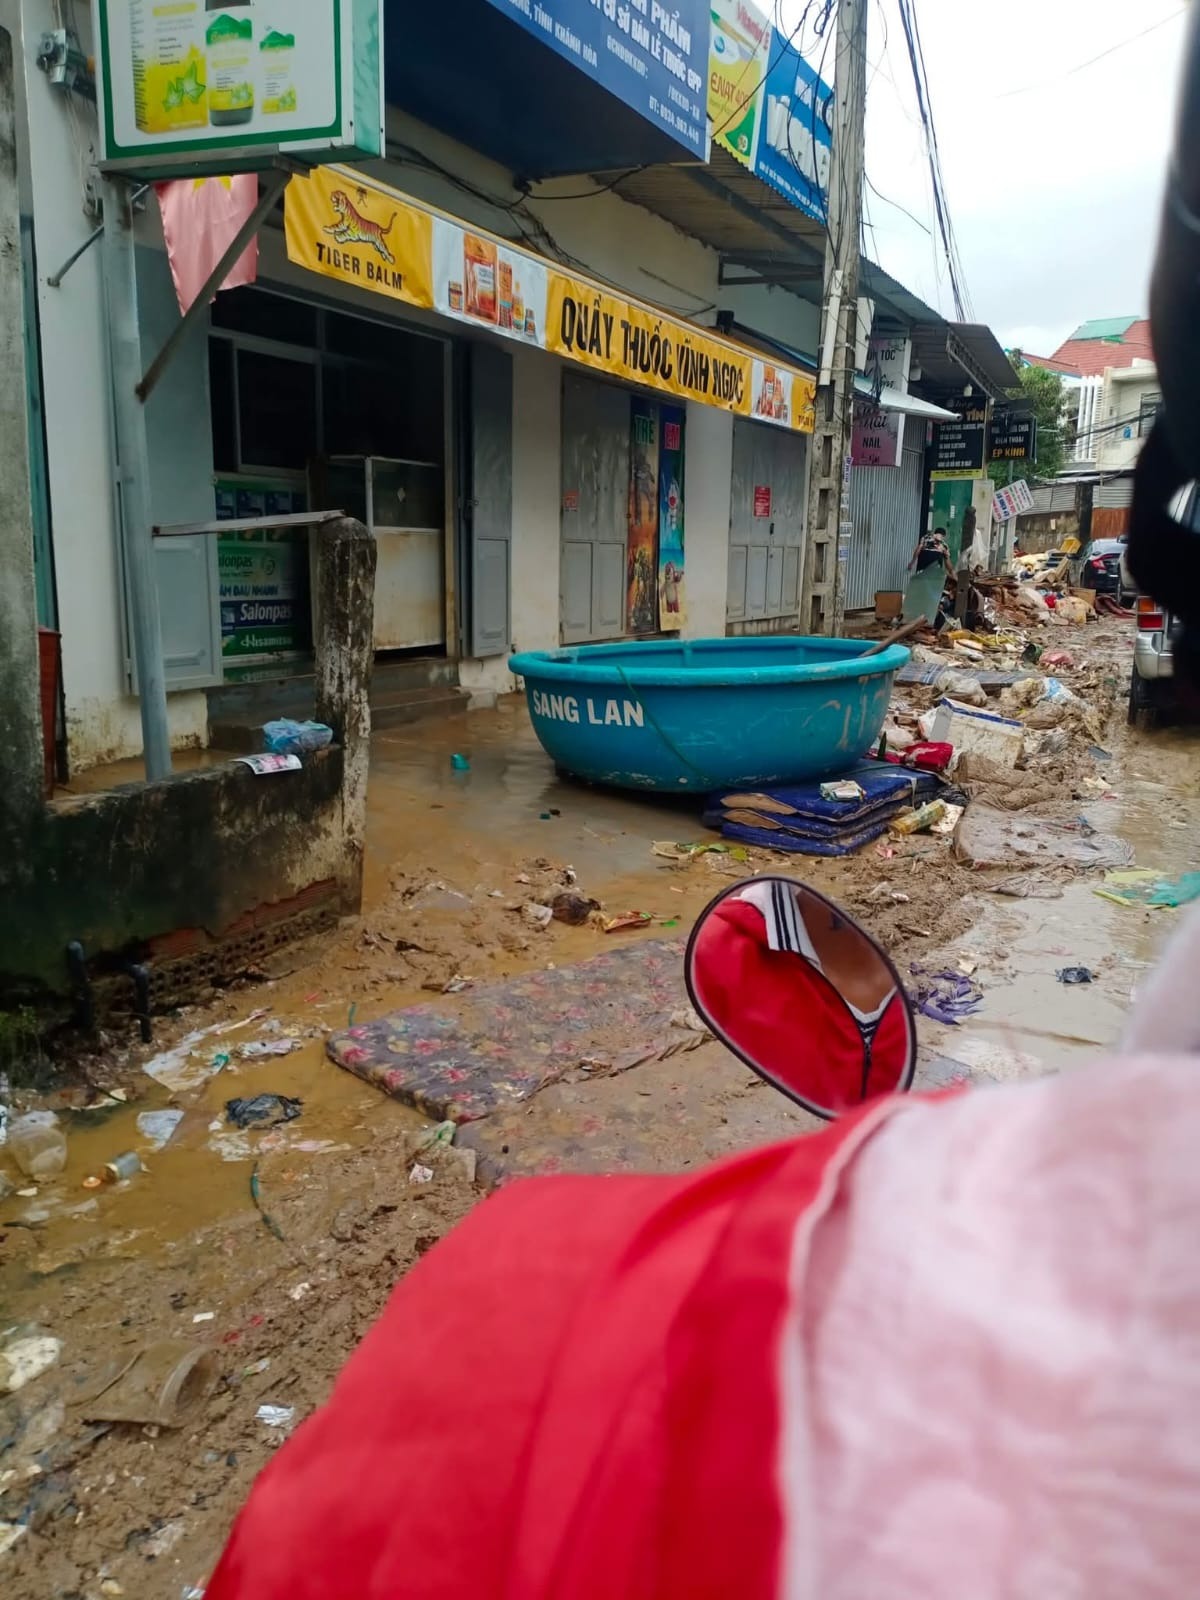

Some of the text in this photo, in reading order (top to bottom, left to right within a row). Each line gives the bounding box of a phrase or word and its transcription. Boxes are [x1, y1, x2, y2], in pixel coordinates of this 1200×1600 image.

[651, 1, 691, 56] PHẨM
[710, 71, 736, 101] ENAT
[316, 241, 402, 290] TIGER BALM
[560, 293, 744, 410] QUẦY THUỐC VĨNH NGỌC
[862, 436, 881, 449] NAIL
[240, 603, 292, 622] Salonpas
[533, 689, 645, 728] SANG LAN
